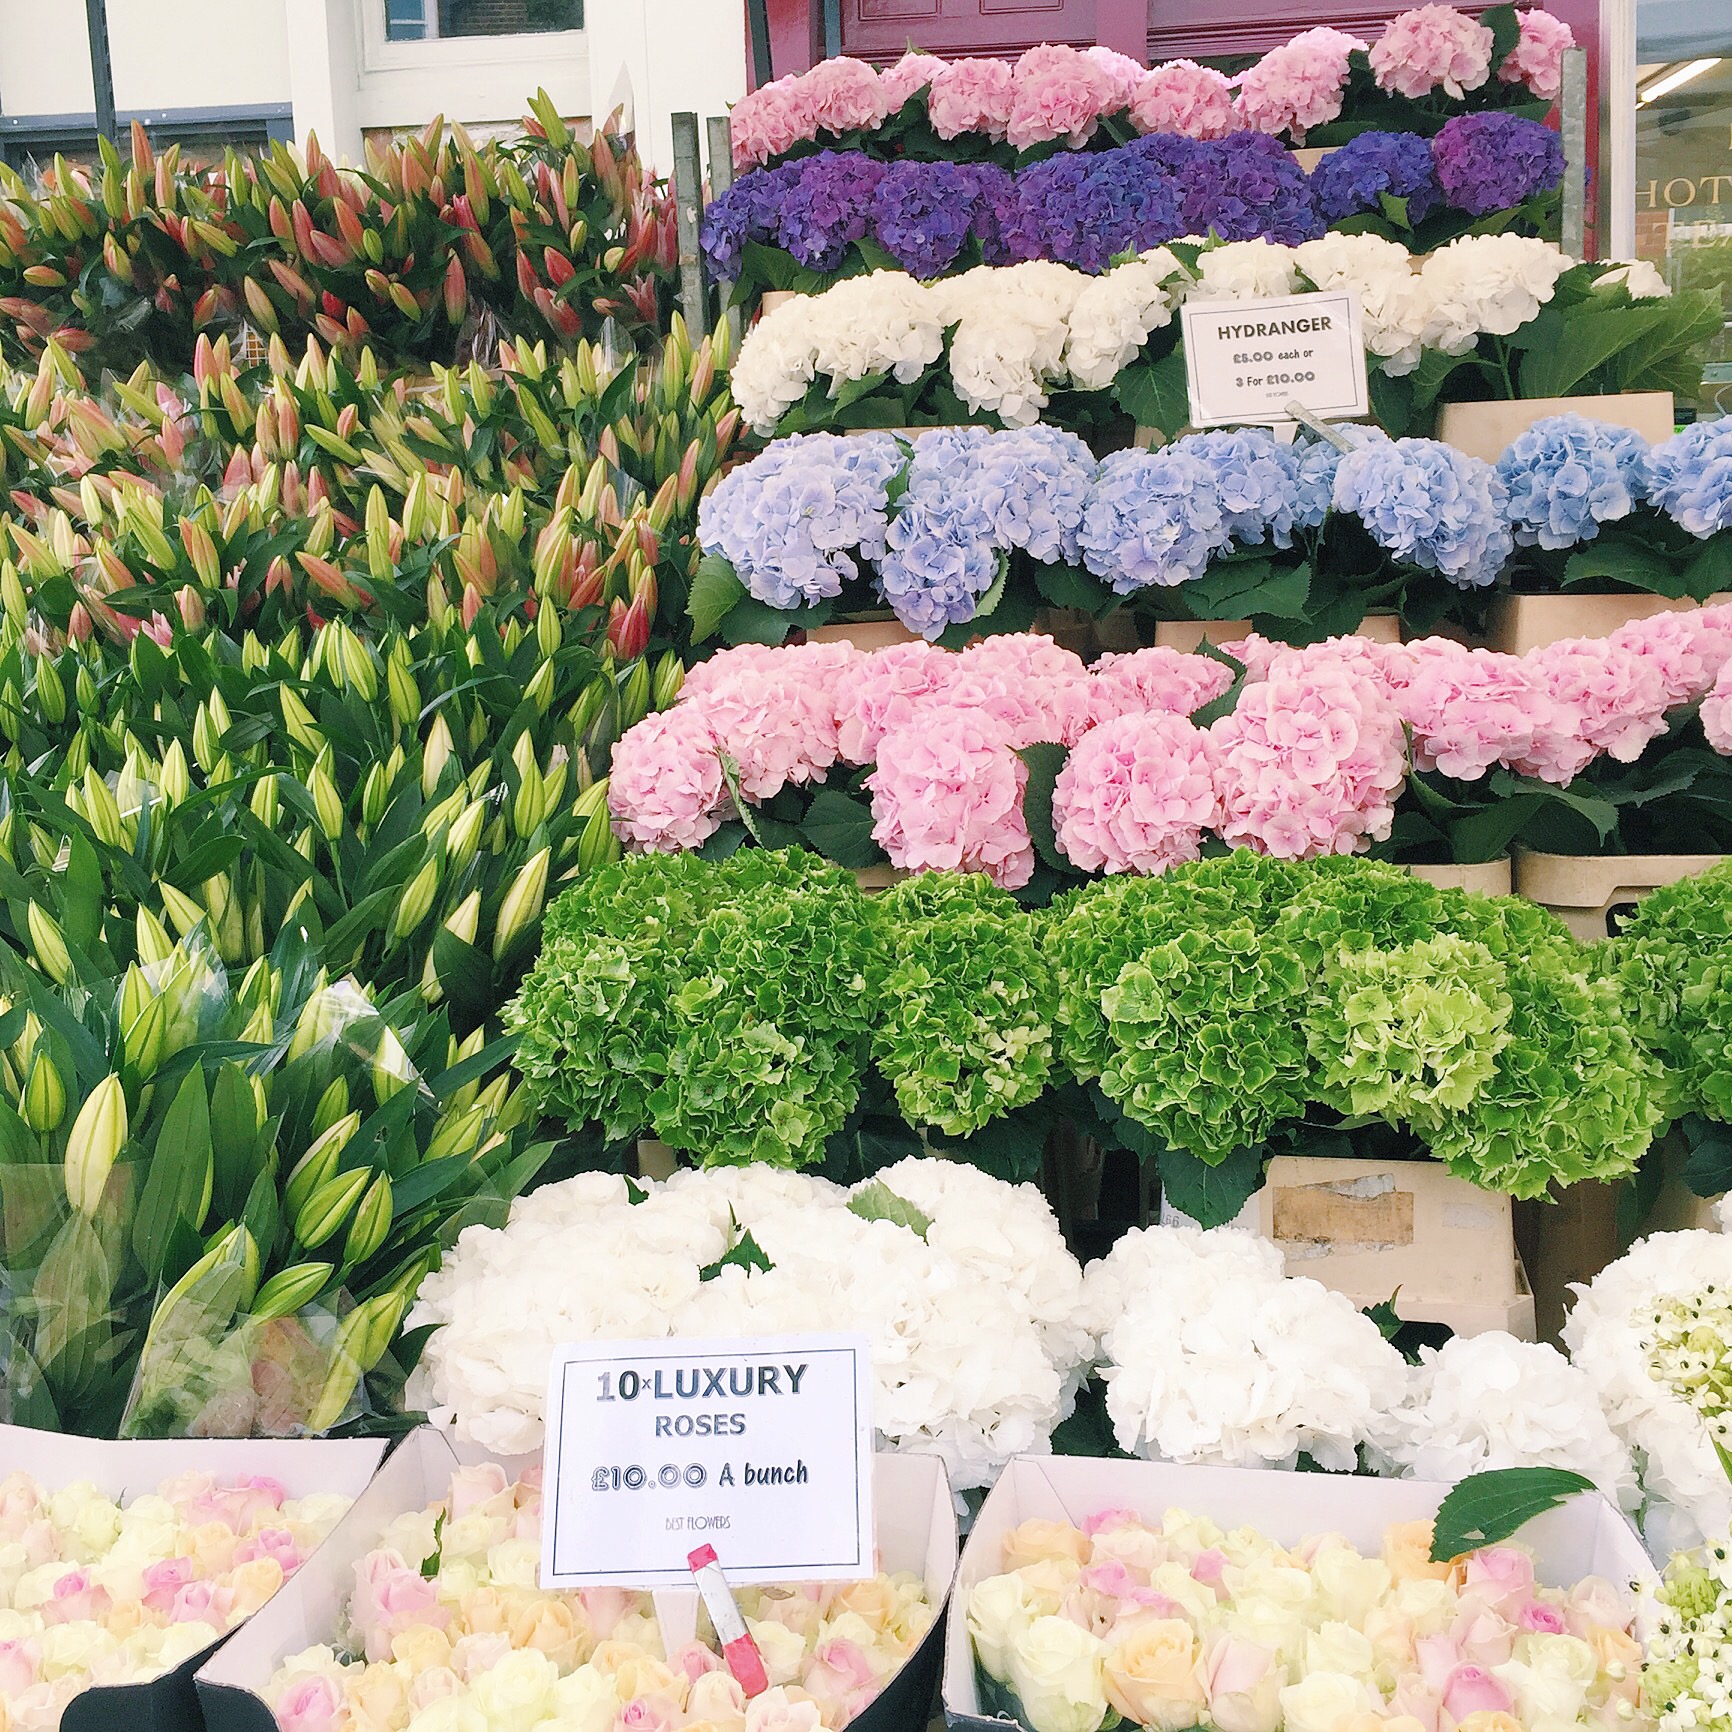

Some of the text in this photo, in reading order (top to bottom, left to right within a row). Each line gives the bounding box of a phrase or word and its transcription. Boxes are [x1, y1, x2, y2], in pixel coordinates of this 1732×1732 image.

[1218, 316, 1332, 340] HYDRANGER
[1232, 349, 1314, 364] £5.00 each or
[1235, 371, 1316, 387] 3 For £10.00
[655, 1412, 746, 1437] ROSES
[591, 1459, 809, 1491] £10.00 A bunch
[665, 1516, 731, 1531] BEST FLOWERS
